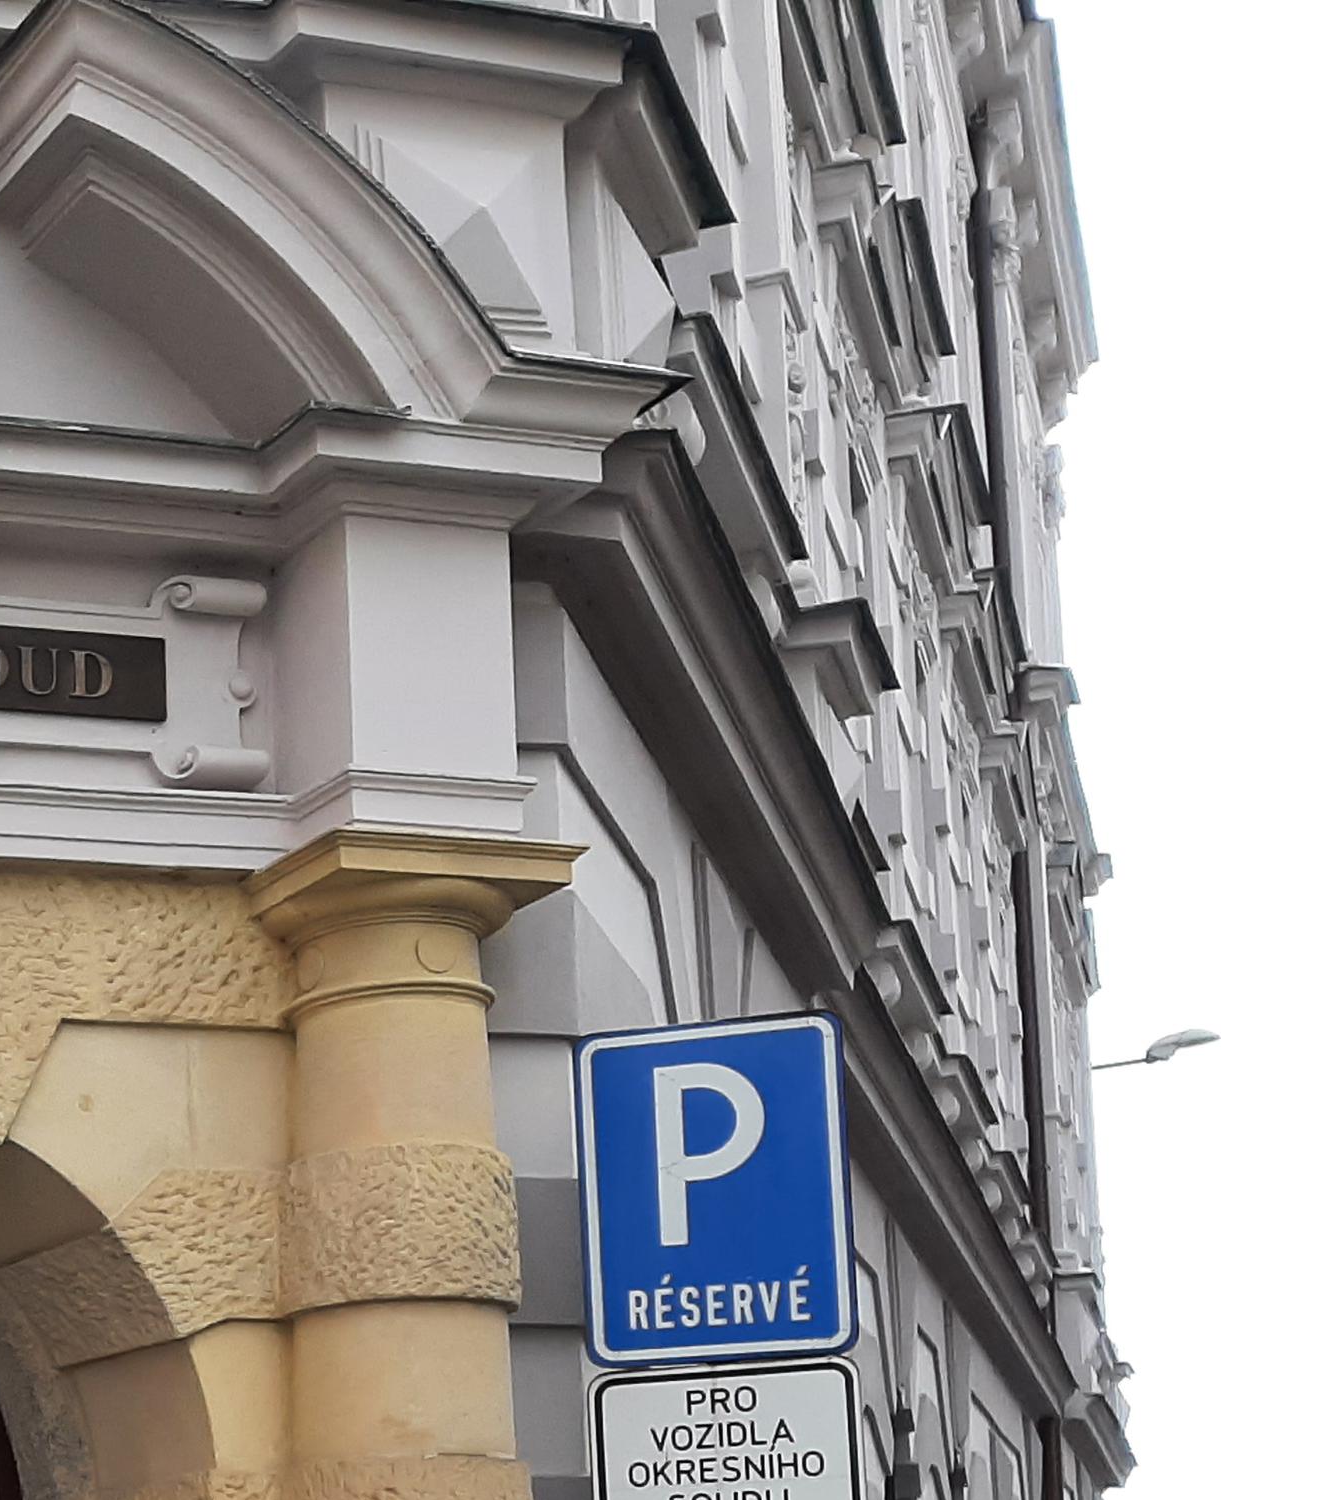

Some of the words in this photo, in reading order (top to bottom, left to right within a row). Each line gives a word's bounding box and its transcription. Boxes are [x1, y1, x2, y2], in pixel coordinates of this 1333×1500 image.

[653, 1062, 765, 1246] P
[628, 1266, 812, 1331] RÉSERVÉ
[685, 1385, 758, 1415] PRO
[650, 1418, 795, 1450] VOZIDLA
[627, 1447, 826, 1487] OKRESNÍHO
